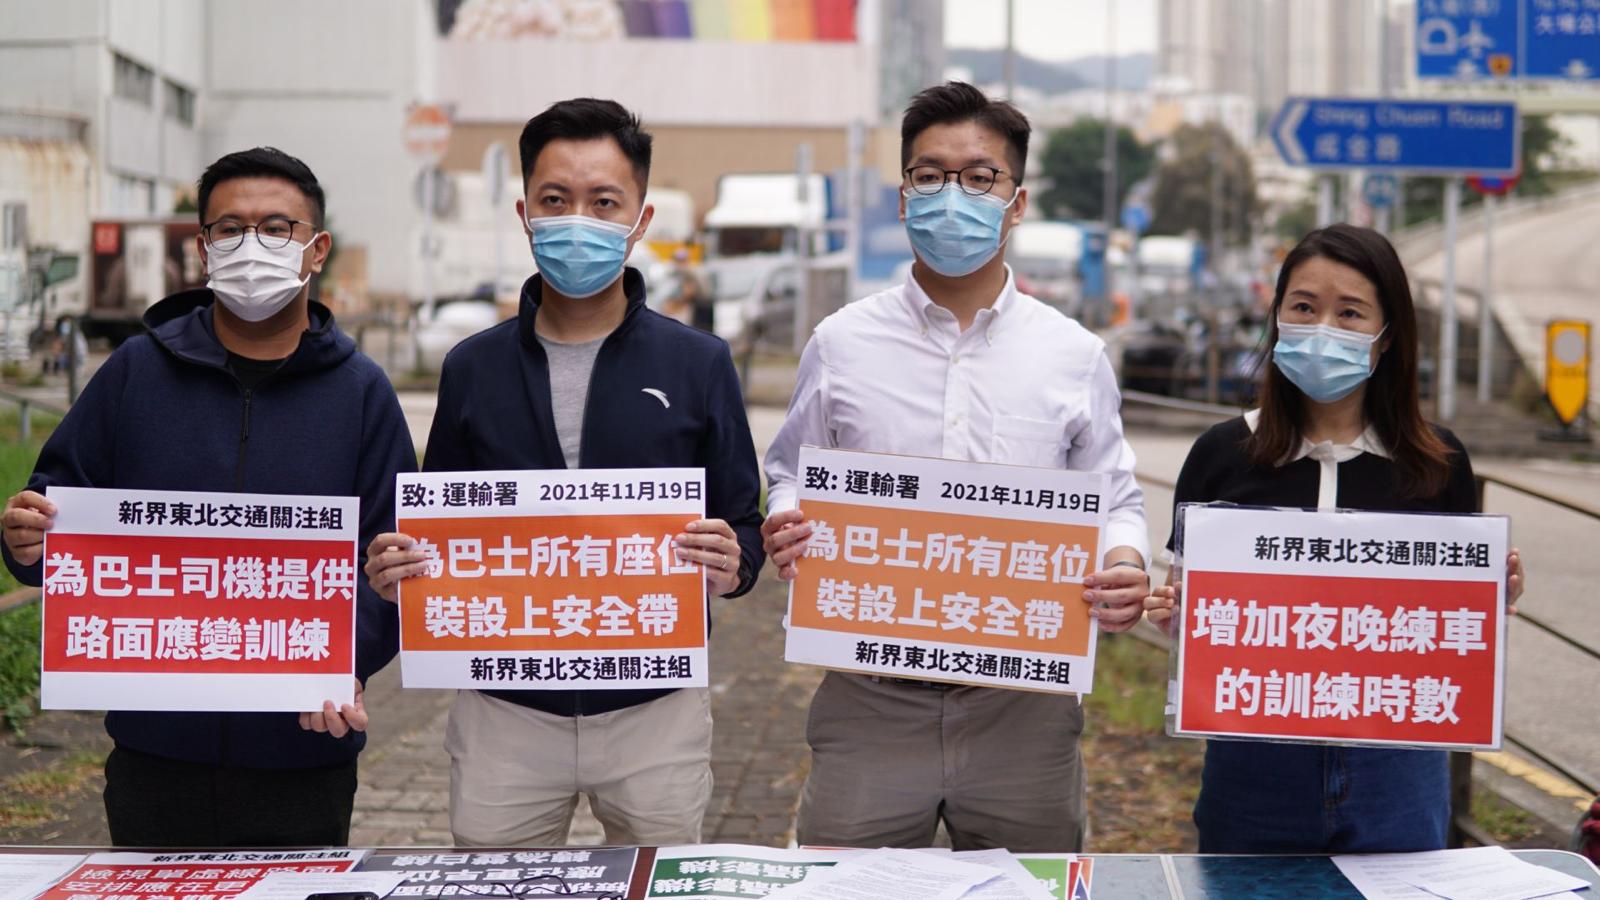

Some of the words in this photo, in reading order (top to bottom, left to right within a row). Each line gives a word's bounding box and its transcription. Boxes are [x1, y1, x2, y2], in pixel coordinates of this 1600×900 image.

[1448, 107, 1504, 129] Road
[401, 483, 435, 508] 致:
[442, 481, 519, 507] 運輸署
[540, 481, 702, 502] 2021年11月19日
[804, 466, 838, 491] 致:
[844, 469, 920, 500] 運輸署
[941, 482, 1100, 514] 2021年11月19日
[118, 500, 344, 530] 新界東北交通關注組
[1254, 535, 1490, 568] 新界東北交通關注組
[45, 552, 354, 601] 為巴士司機提供
[425, 594, 679, 639] 裝設上安全帶
[816, 578, 1065, 641] 裝設上安全帶
[66, 615, 331, 662] 路面應變訓練
[1191, 598, 1488, 656] 增加夜晚練車
[471, 656, 693, 682] 新界東北交通關注組
[855, 641, 1071, 686] 新界東北交通關注組
[1214, 667, 1462, 725] 的訓練時數
[152, 851, 351, 862] 新界東北交通關注組
